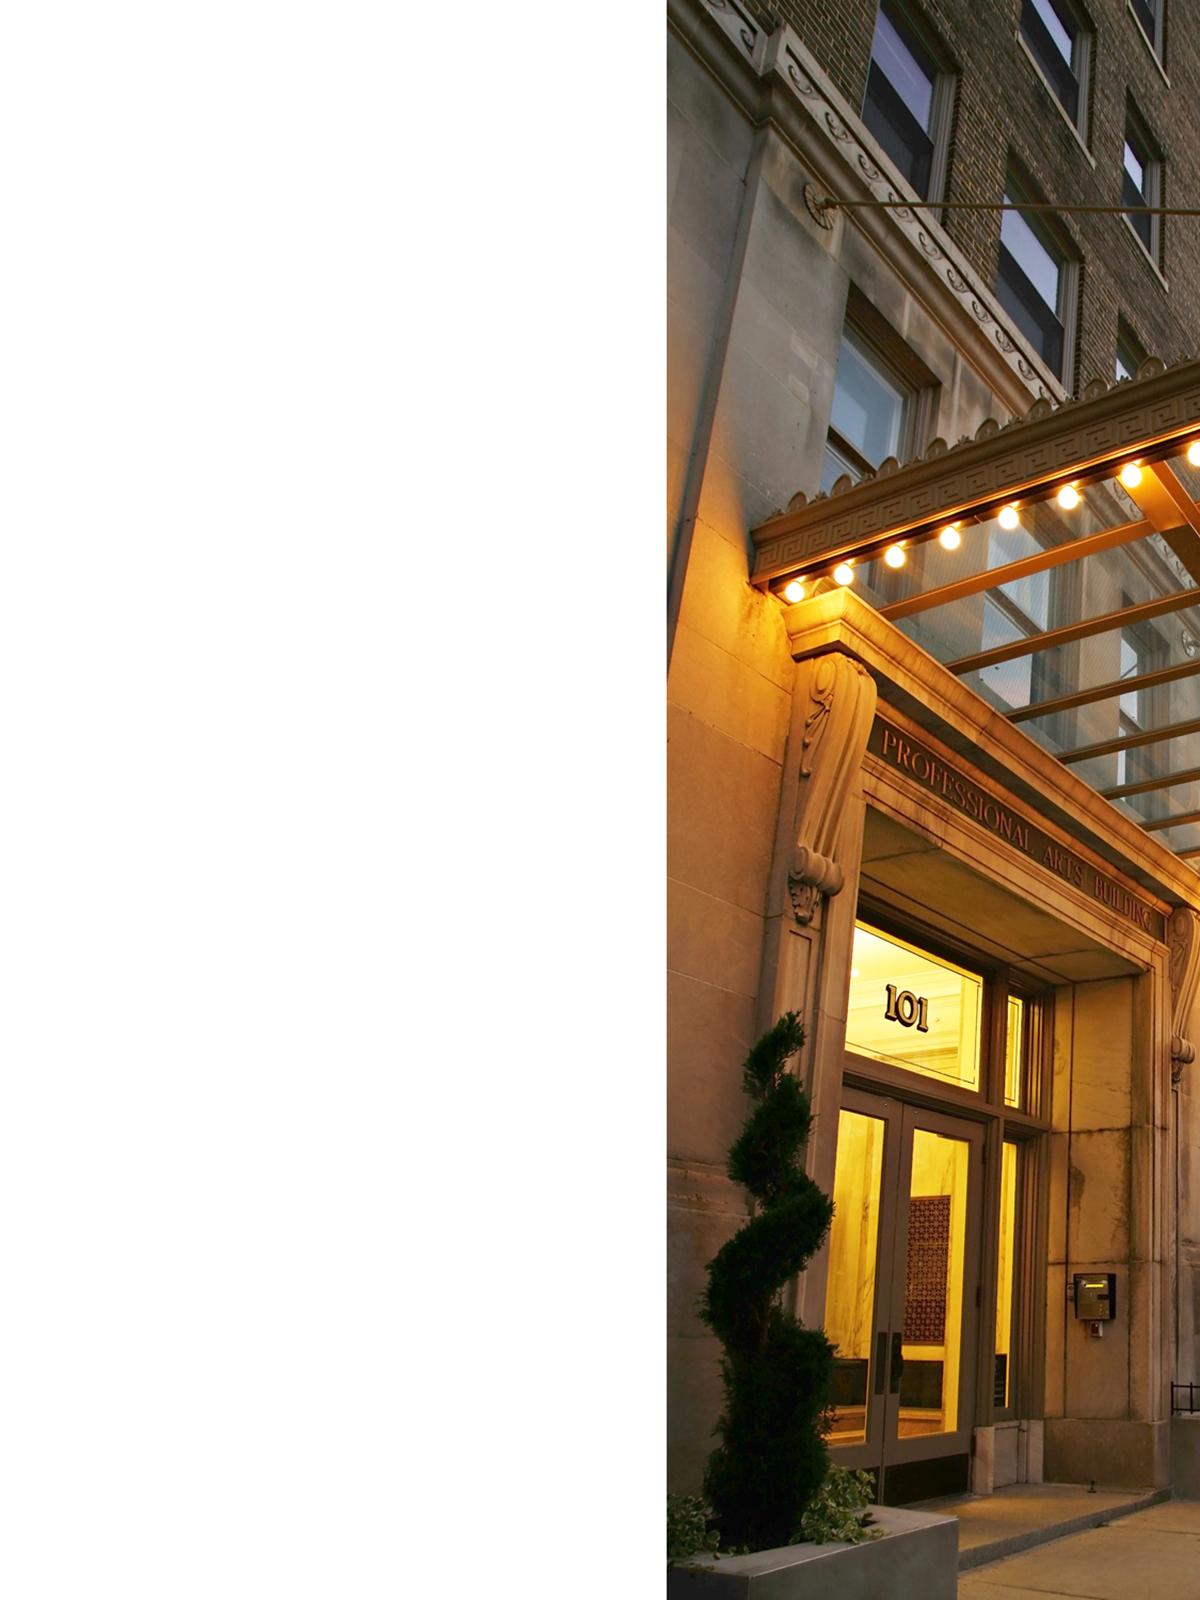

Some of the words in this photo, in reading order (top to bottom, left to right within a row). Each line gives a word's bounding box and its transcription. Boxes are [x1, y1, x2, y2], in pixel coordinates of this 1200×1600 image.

[881, 730, 1034, 855] PROFESSIONAL
[1042, 845, 1084, 887] ARTS
[1094, 874, 1152, 932] BUILDING
[885, 984, 928, 1032] 101
